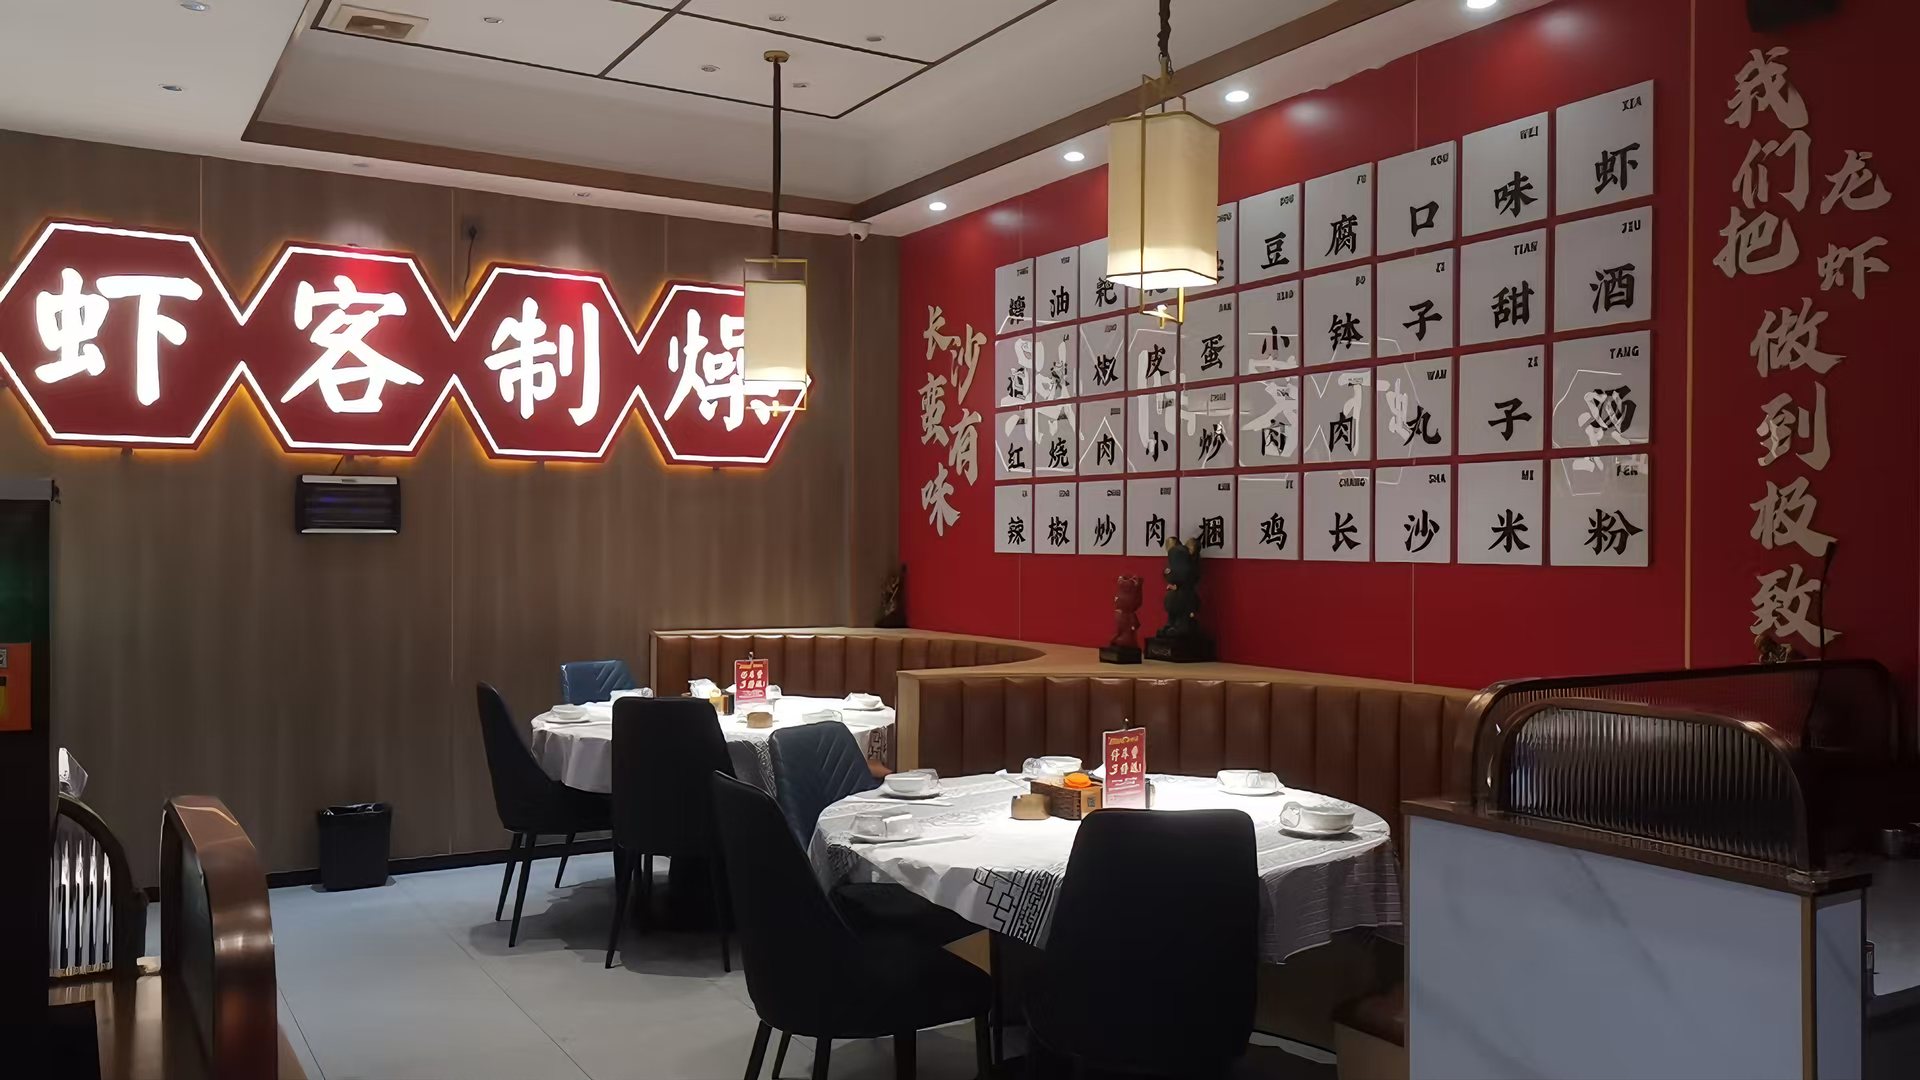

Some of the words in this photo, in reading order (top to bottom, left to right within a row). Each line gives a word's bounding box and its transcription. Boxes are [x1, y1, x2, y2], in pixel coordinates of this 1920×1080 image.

[1050, 286, 1069, 317] 油
[1261, 232, 1289, 269] 豆
[1325, 214, 1358, 257] 腐
[1410, 201, 1439, 237] 口
[1494, 171, 1538, 218] 味
[1595, 142, 1640, 194] 虾
[1817, 149, 1892, 300] 龙虾
[1146, 344, 1169, 378] 皮
[1201, 334, 1224, 371] 蛋
[1262, 326, 1289, 354] 小
[1328, 313, 1363, 351] 钵
[1403, 300, 1442, 341] 子
[1491, 281, 1534, 328] 甜
[1590, 263, 1635, 313] 酒
[917, 304, 987, 537] 长沙蛮有味
[1008, 443, 1025, 469] 红
[1097, 434, 1115, 465] 肉
[1146, 431, 1168, 462] 小
[1199, 424, 1225, 461] 炒
[1329, 412, 1353, 452] 肉
[1404, 406, 1441, 446] 丸
[1488, 398, 1532, 441] 子
[1750, 297, 1847, 648] 做到极致
[1008, 517, 1025, 545] 辣
[1048, 517, 1069, 547] 椒
[1094, 515, 1116, 546] 炒
[1146, 514, 1165, 547] 肉
[1199, 516, 1224, 549] 捆
[1259, 513, 1287, 550] 鸡
[1329, 512, 1361, 552] 长
[1404, 510, 1439, 552] 沙
[1488, 509, 1530, 552] 米
[1584, 509, 1643, 555] 粉
